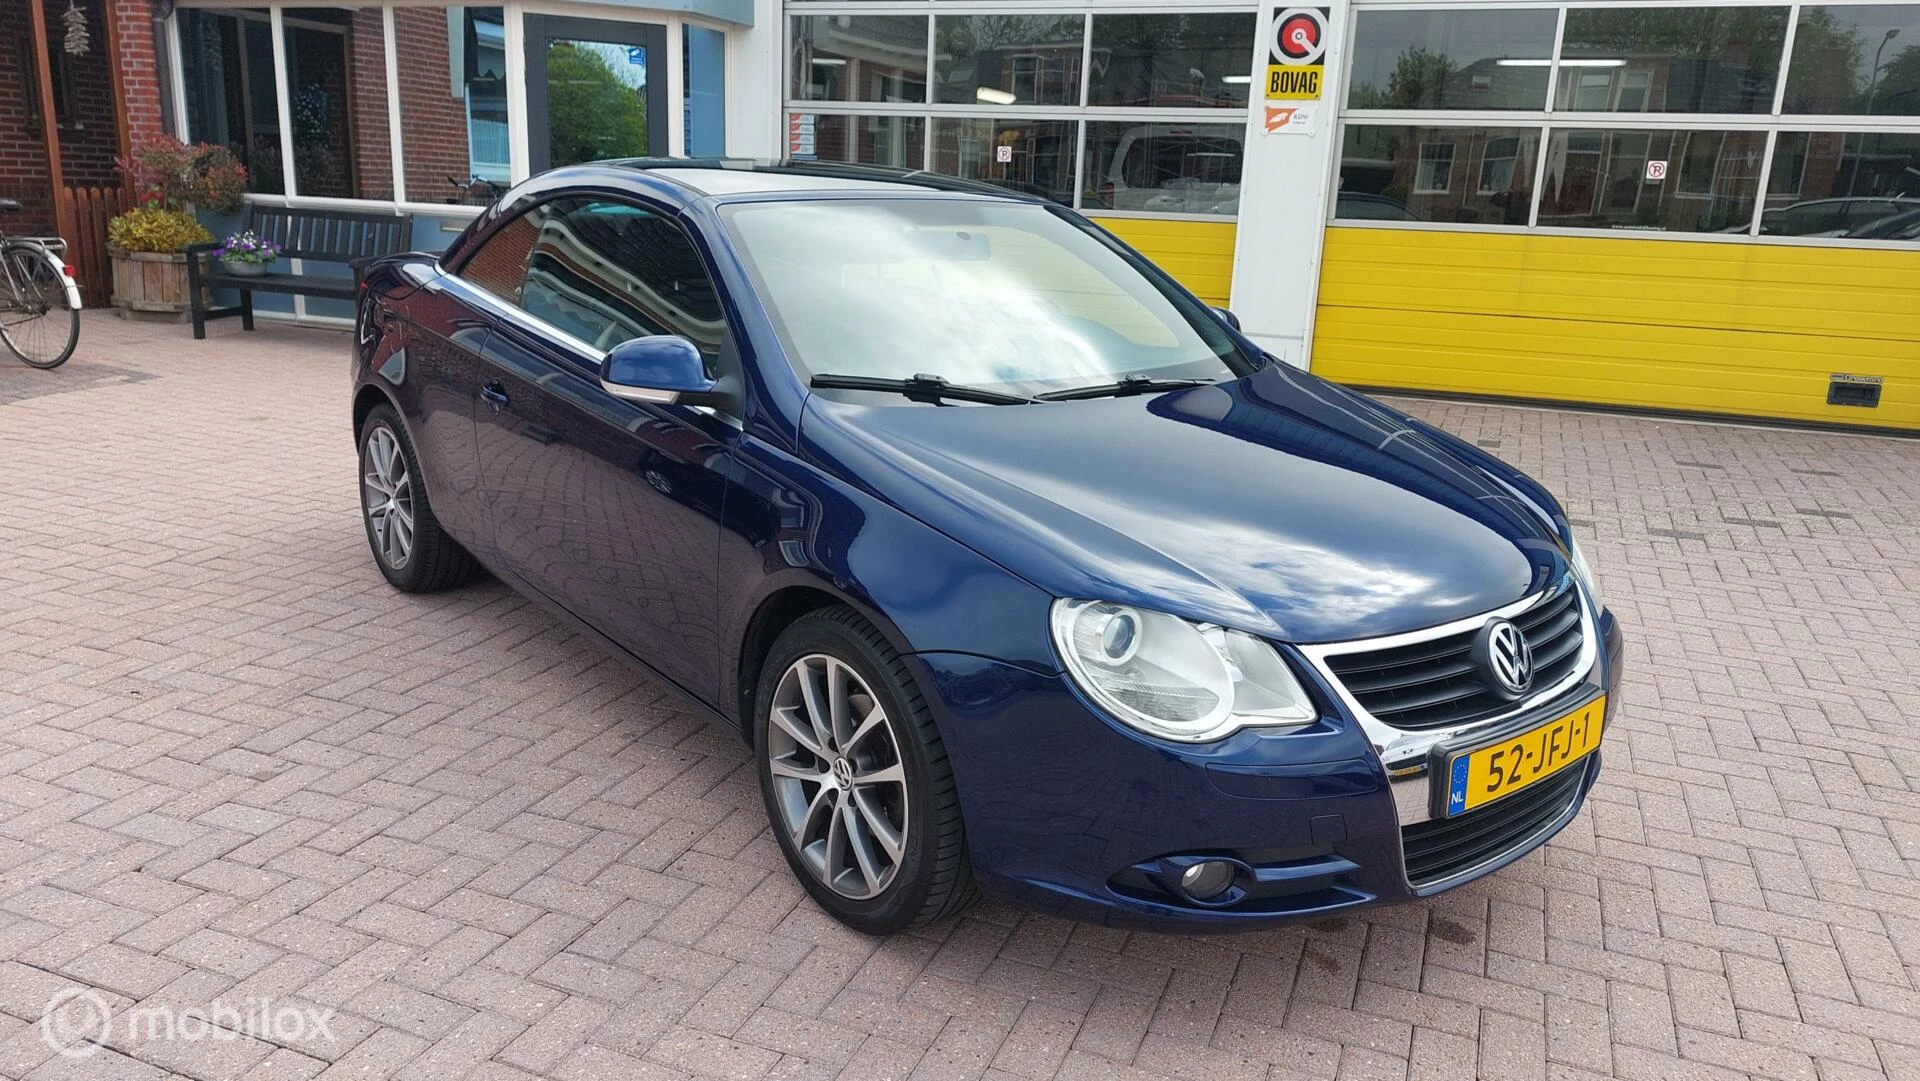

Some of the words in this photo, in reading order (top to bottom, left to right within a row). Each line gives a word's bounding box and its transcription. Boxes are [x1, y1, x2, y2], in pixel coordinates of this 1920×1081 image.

[1270, 71, 1318, 94] BOVAG
[1486, 711, 1590, 793] 52-JFJ-1
[1450, 790, 1465, 805] NL
